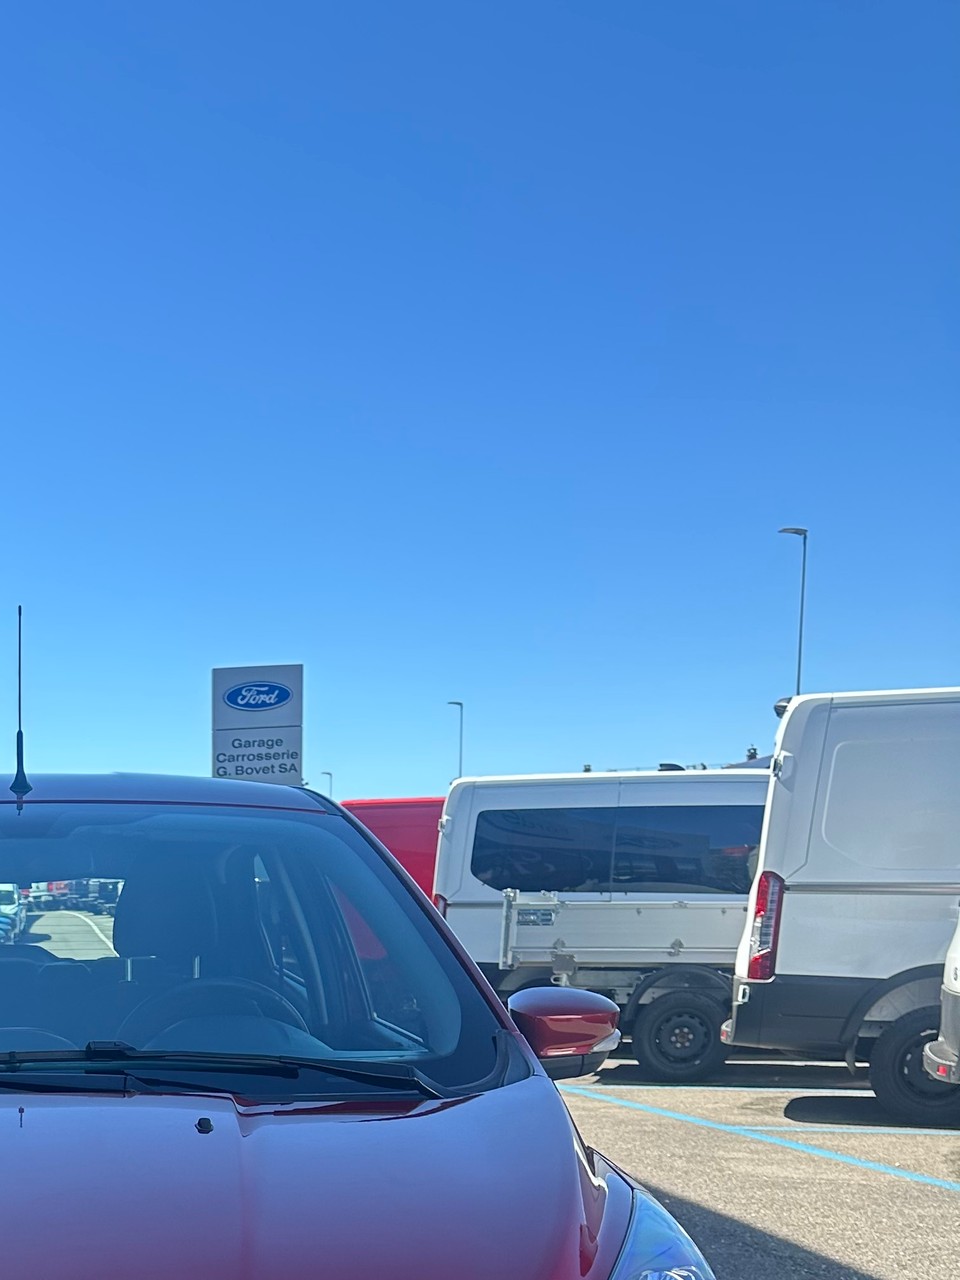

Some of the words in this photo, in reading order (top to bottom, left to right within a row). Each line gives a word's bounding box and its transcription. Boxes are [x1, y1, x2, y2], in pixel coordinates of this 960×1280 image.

[237, 686, 280, 705] Ford
[231, 738, 284, 750] Garage
[215, 749, 299, 764] Carrosserie
[216, 765, 232, 777] G.
[235, 764, 276, 776] Bovet
[278, 762, 298, 774] SA
